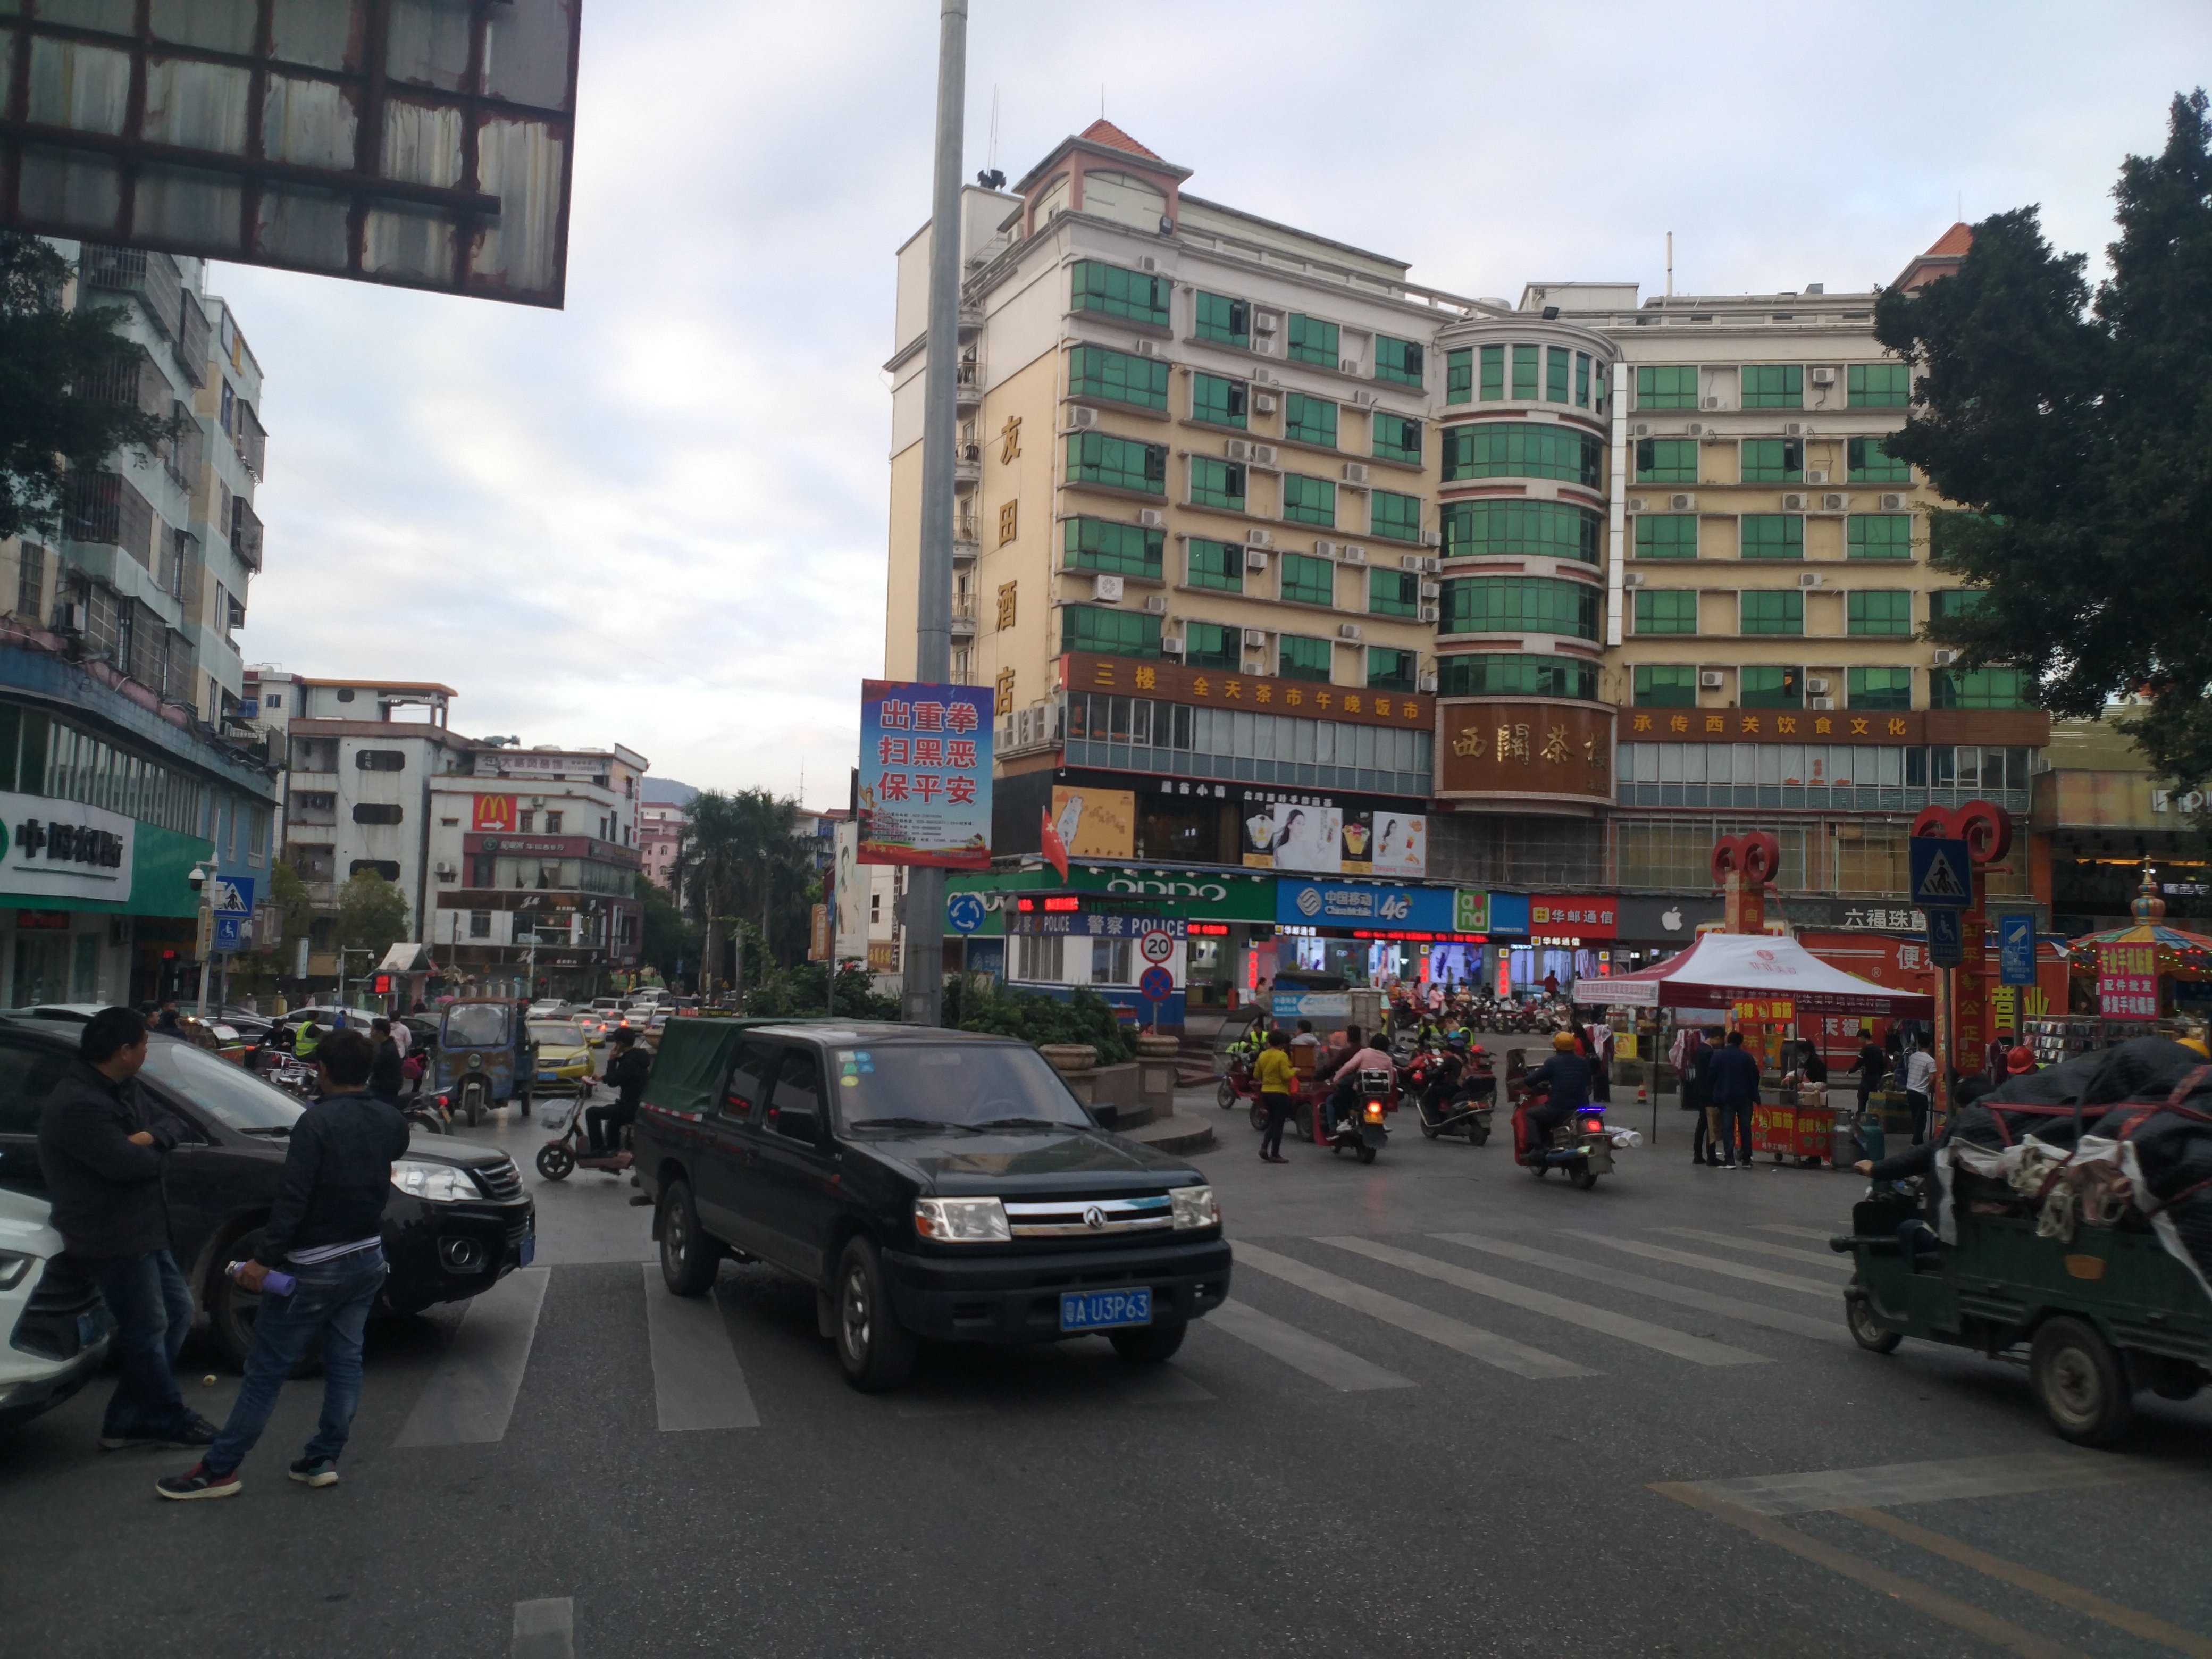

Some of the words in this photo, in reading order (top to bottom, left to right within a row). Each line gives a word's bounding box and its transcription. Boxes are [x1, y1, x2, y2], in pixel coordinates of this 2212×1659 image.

[994, 415, 1022, 717] 友田酒店
[1094, 662, 1155, 690] 三楼
[1193, 677, 1419, 719] 全天茶市午晚饭市
[880, 699, 978, 734] 出重拳
[1633, 714, 1907, 736] 承传西关饮食文化
[878, 736, 978, 769] 扫黑恶
[877, 771, 977, 805] 保平安
[1325, 890, 1372, 906] 中国移动
[1380, 894, 1409, 920] 4G
[1043, 915, 1070, 932] POLICE
[1087, 914, 1124, 935] 警察
[1131, 918, 1185, 937] POLICE
[1552, 909, 1614, 925] 华邮通信
[1845, 908, 1926, 929] 六福珠寶
[1147, 939, 1168, 954] 20
[1543, 936, 1580, 946] 华邮通信
[1958, 901, 1978, 1069] 由平等公正法
[2102, 979, 2151, 992] 配件批发
[1991, 985, 2050, 1029] 营业
[1820, 1018, 1859, 1036] 天福
